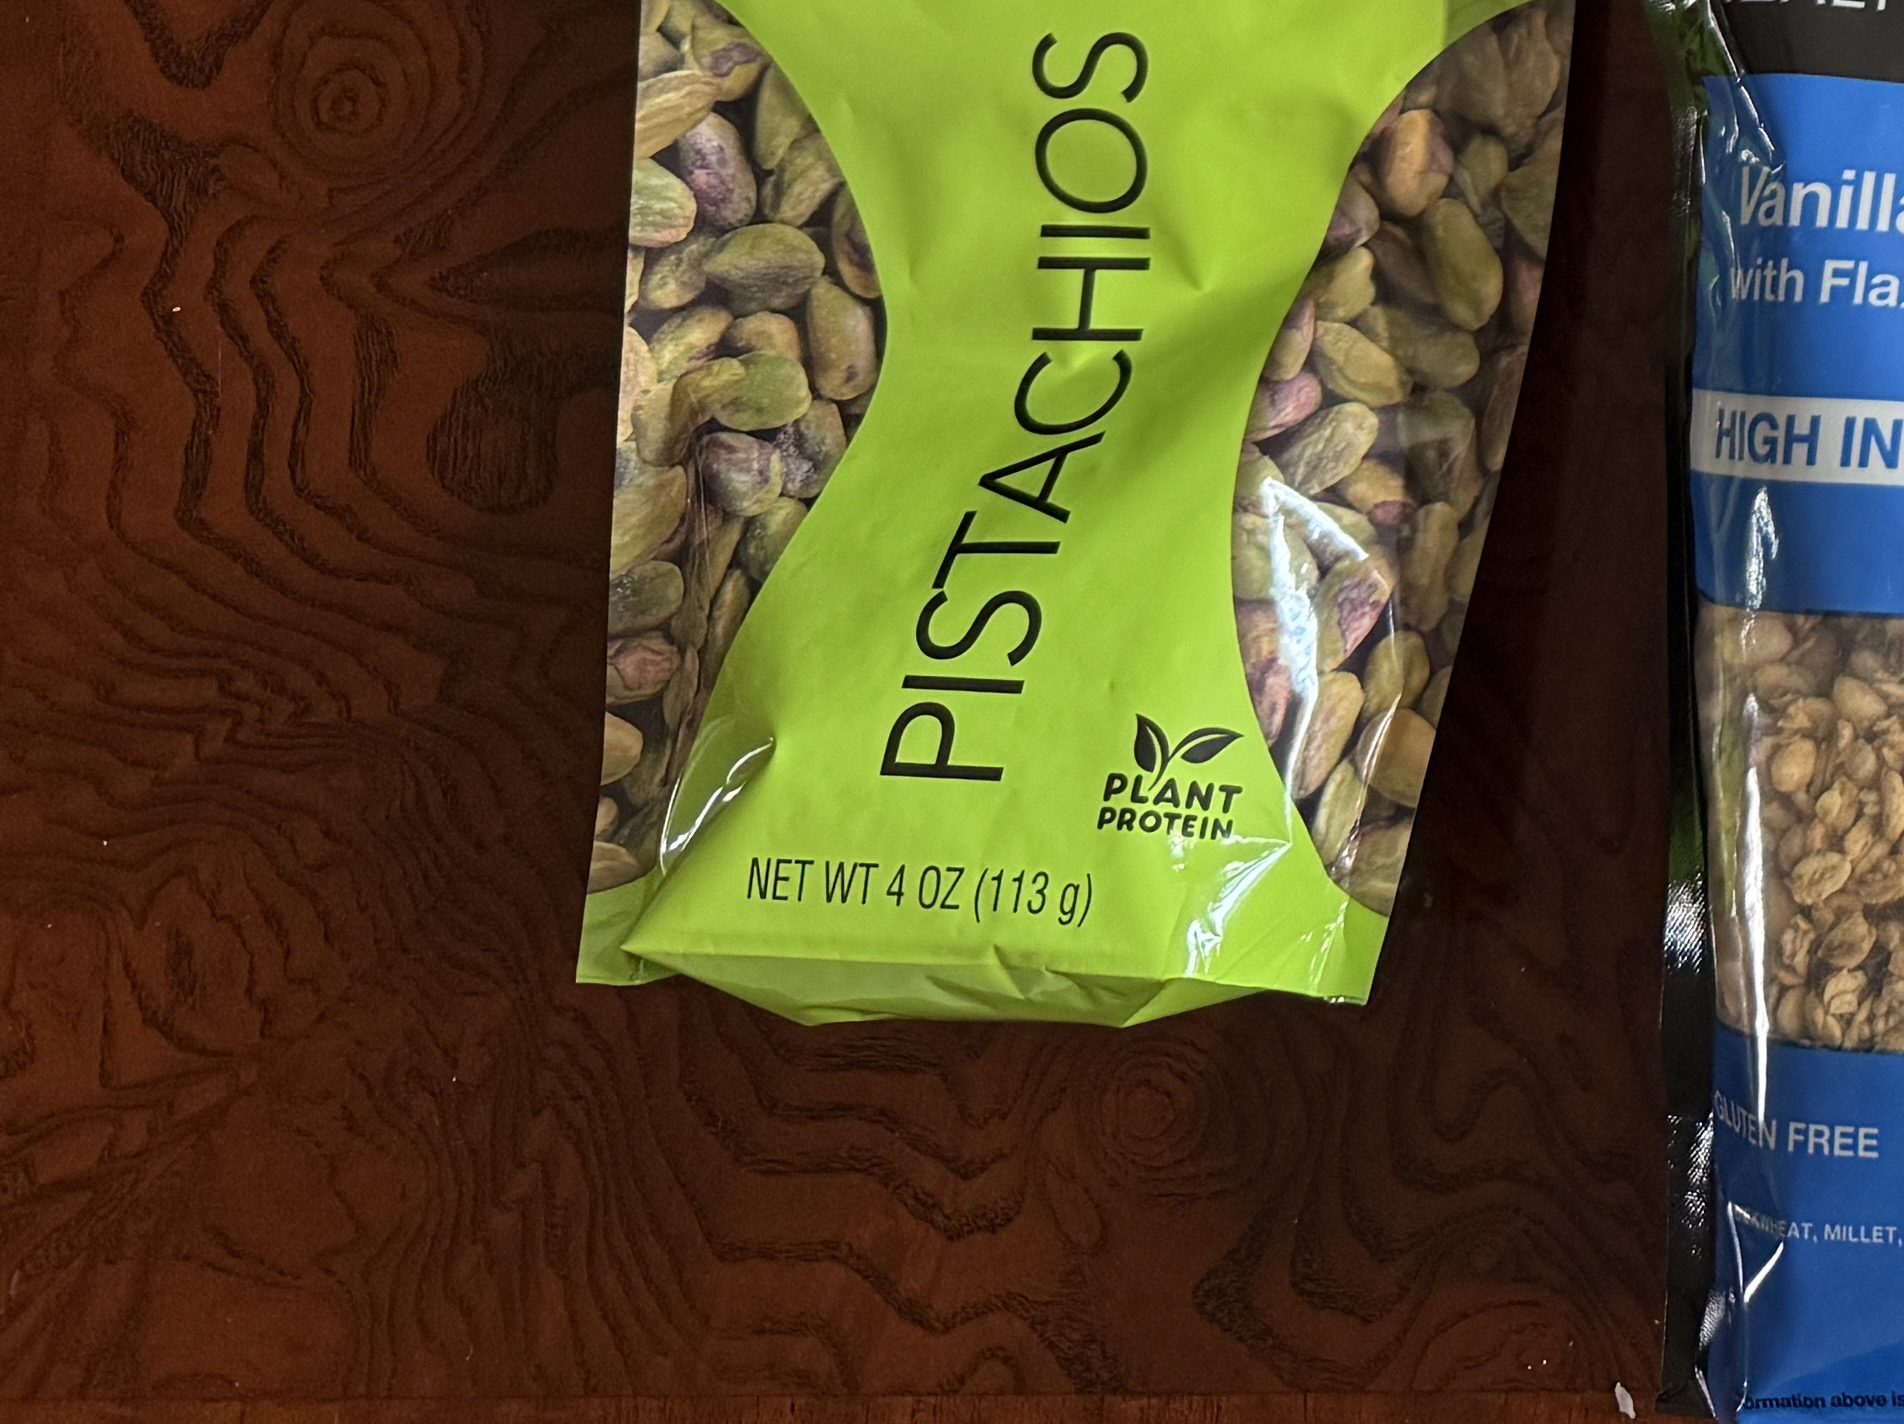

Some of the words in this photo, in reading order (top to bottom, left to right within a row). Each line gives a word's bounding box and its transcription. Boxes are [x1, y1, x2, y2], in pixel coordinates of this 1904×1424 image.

[879, 30, 1150, 782] PISTACHIOS
[1103, 774, 1244, 814] PLANT
[1097, 806, 1233, 840] PROTEIN
[747, 857, 815, 902] NET
[823, 860, 879, 905] WT
[886, 865, 905, 907] 4
[918, 865, 962, 910] OZ
[974, 867, 1048, 923] (113
[1058, 872, 1093, 928] g)
